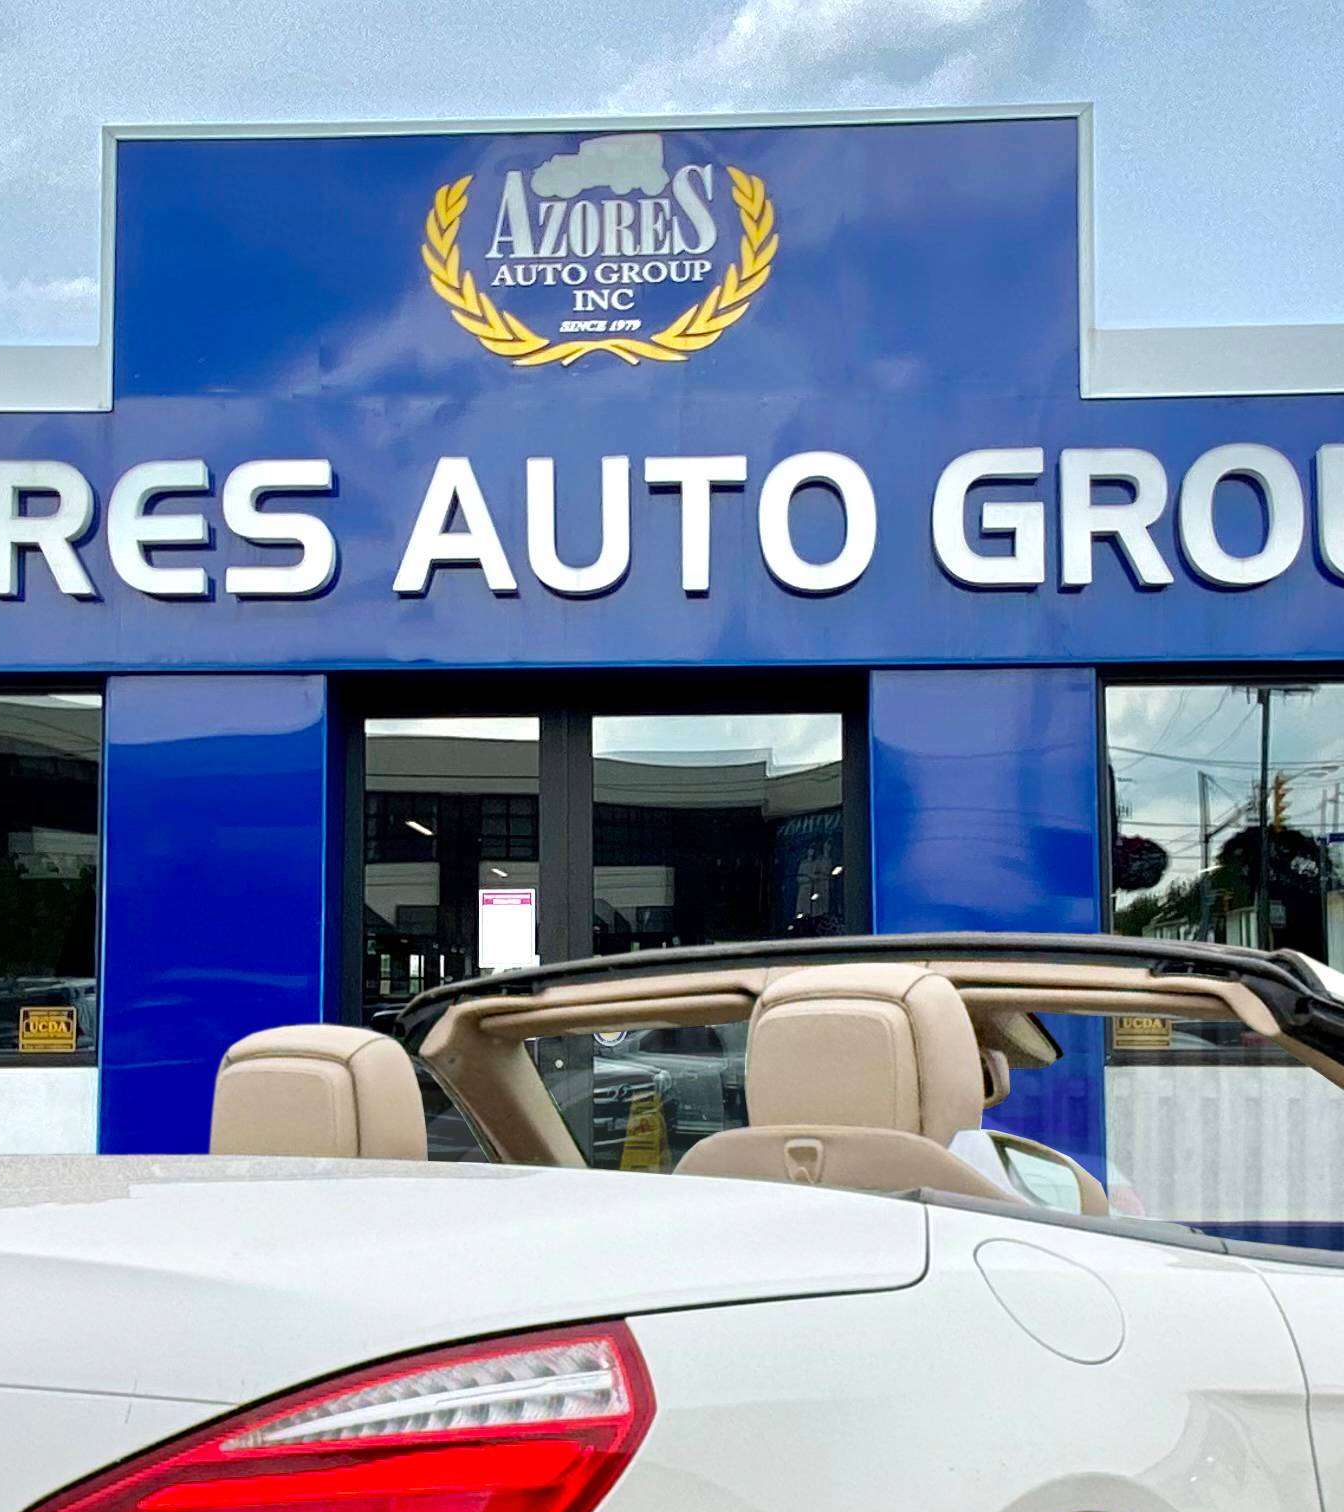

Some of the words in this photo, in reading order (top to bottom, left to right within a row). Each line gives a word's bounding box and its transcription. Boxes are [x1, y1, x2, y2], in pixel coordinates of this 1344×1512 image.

[485, 163, 718, 259] AZORES
[491, 263, 588, 287] AUTO
[594, 260, 712, 285] GROUP
[572, 288, 635, 311] INC
[559, 320, 608, 333] SINCE
[391, 449, 878, 597] AUTO
[29, 1021, 68, 1032] UCDA
[1122, 1016, 1164, 1029] UCDA
